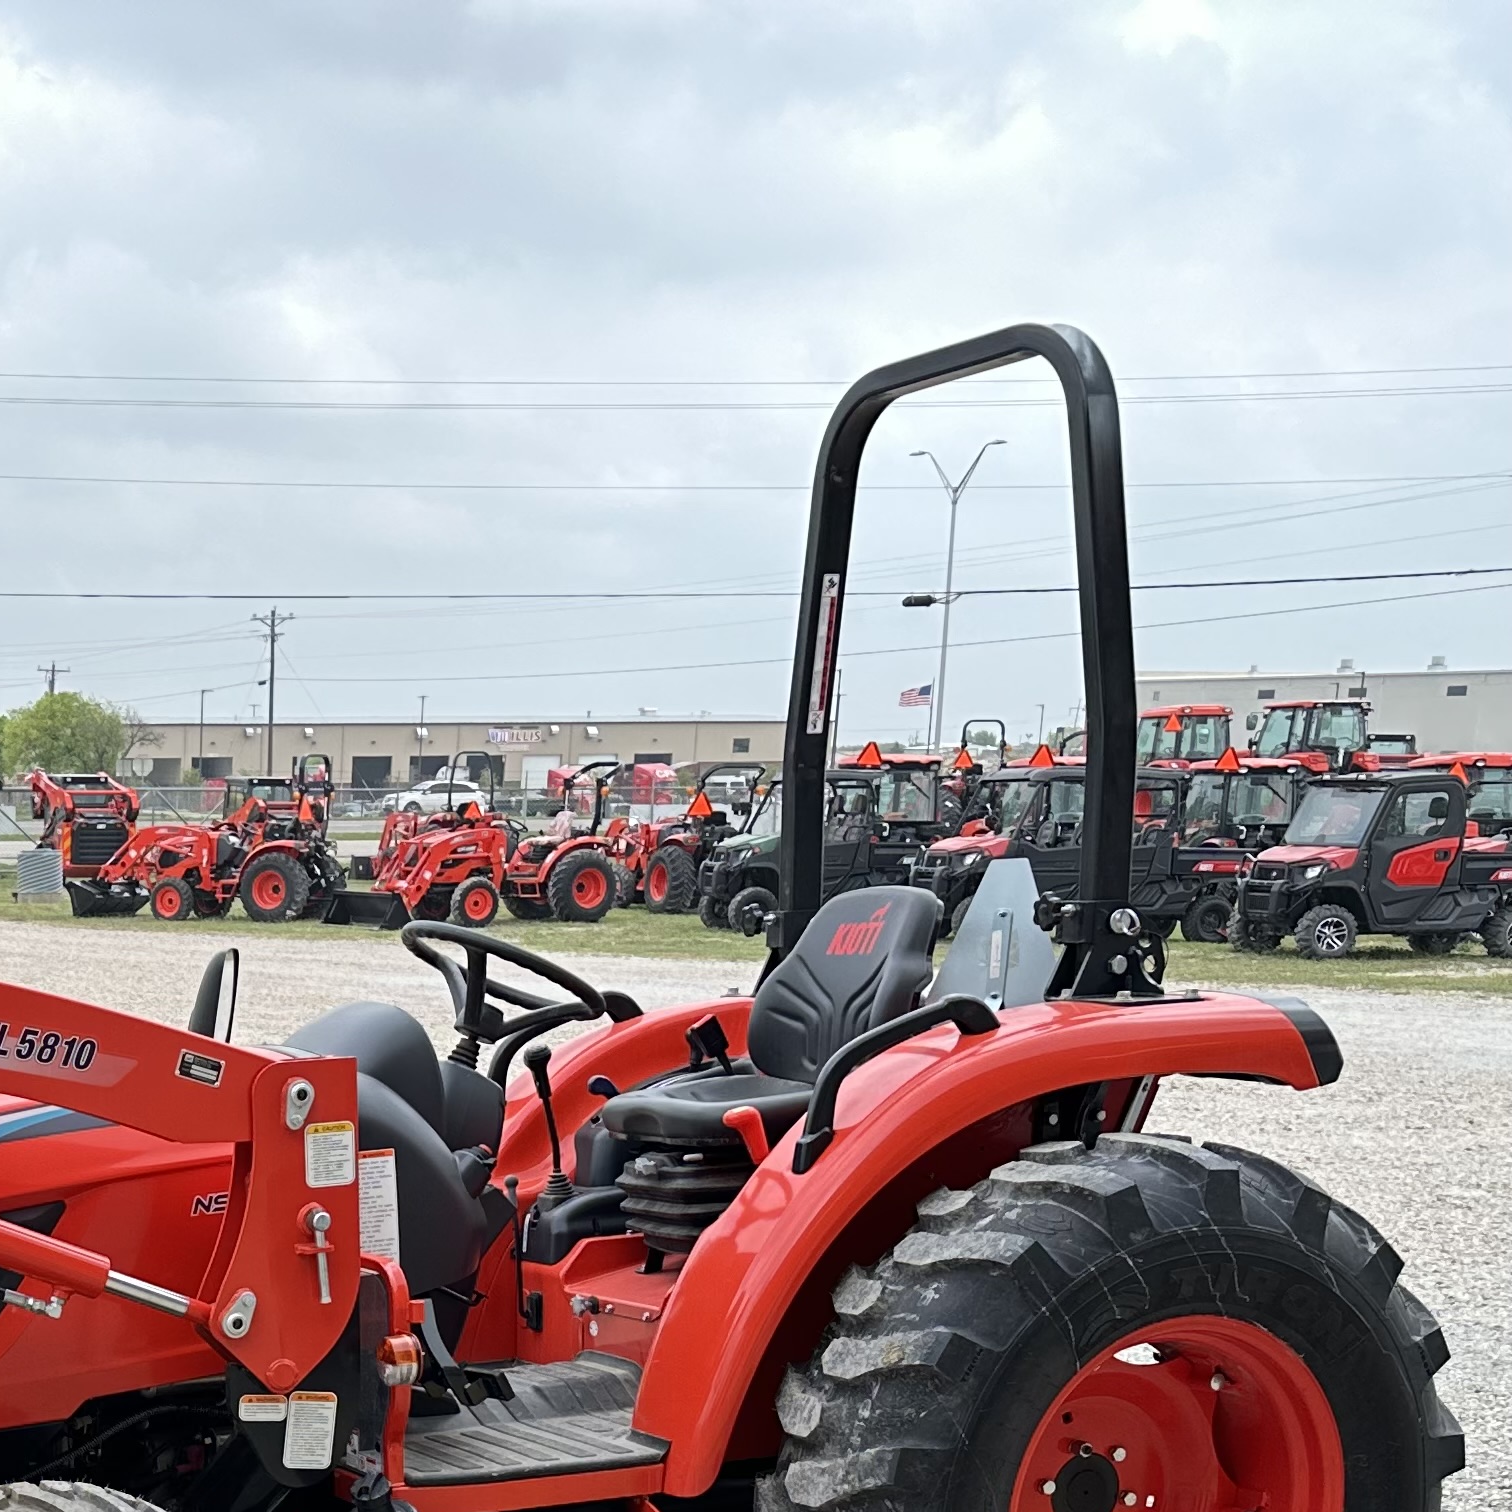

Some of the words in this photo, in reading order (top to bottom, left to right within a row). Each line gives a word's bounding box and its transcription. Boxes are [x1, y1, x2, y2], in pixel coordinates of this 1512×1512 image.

[825, 920, 886, 955] KIOTI
[14, 1027, 99, 1072] 5810
[322, 1124, 346, 1132] CAUTION
